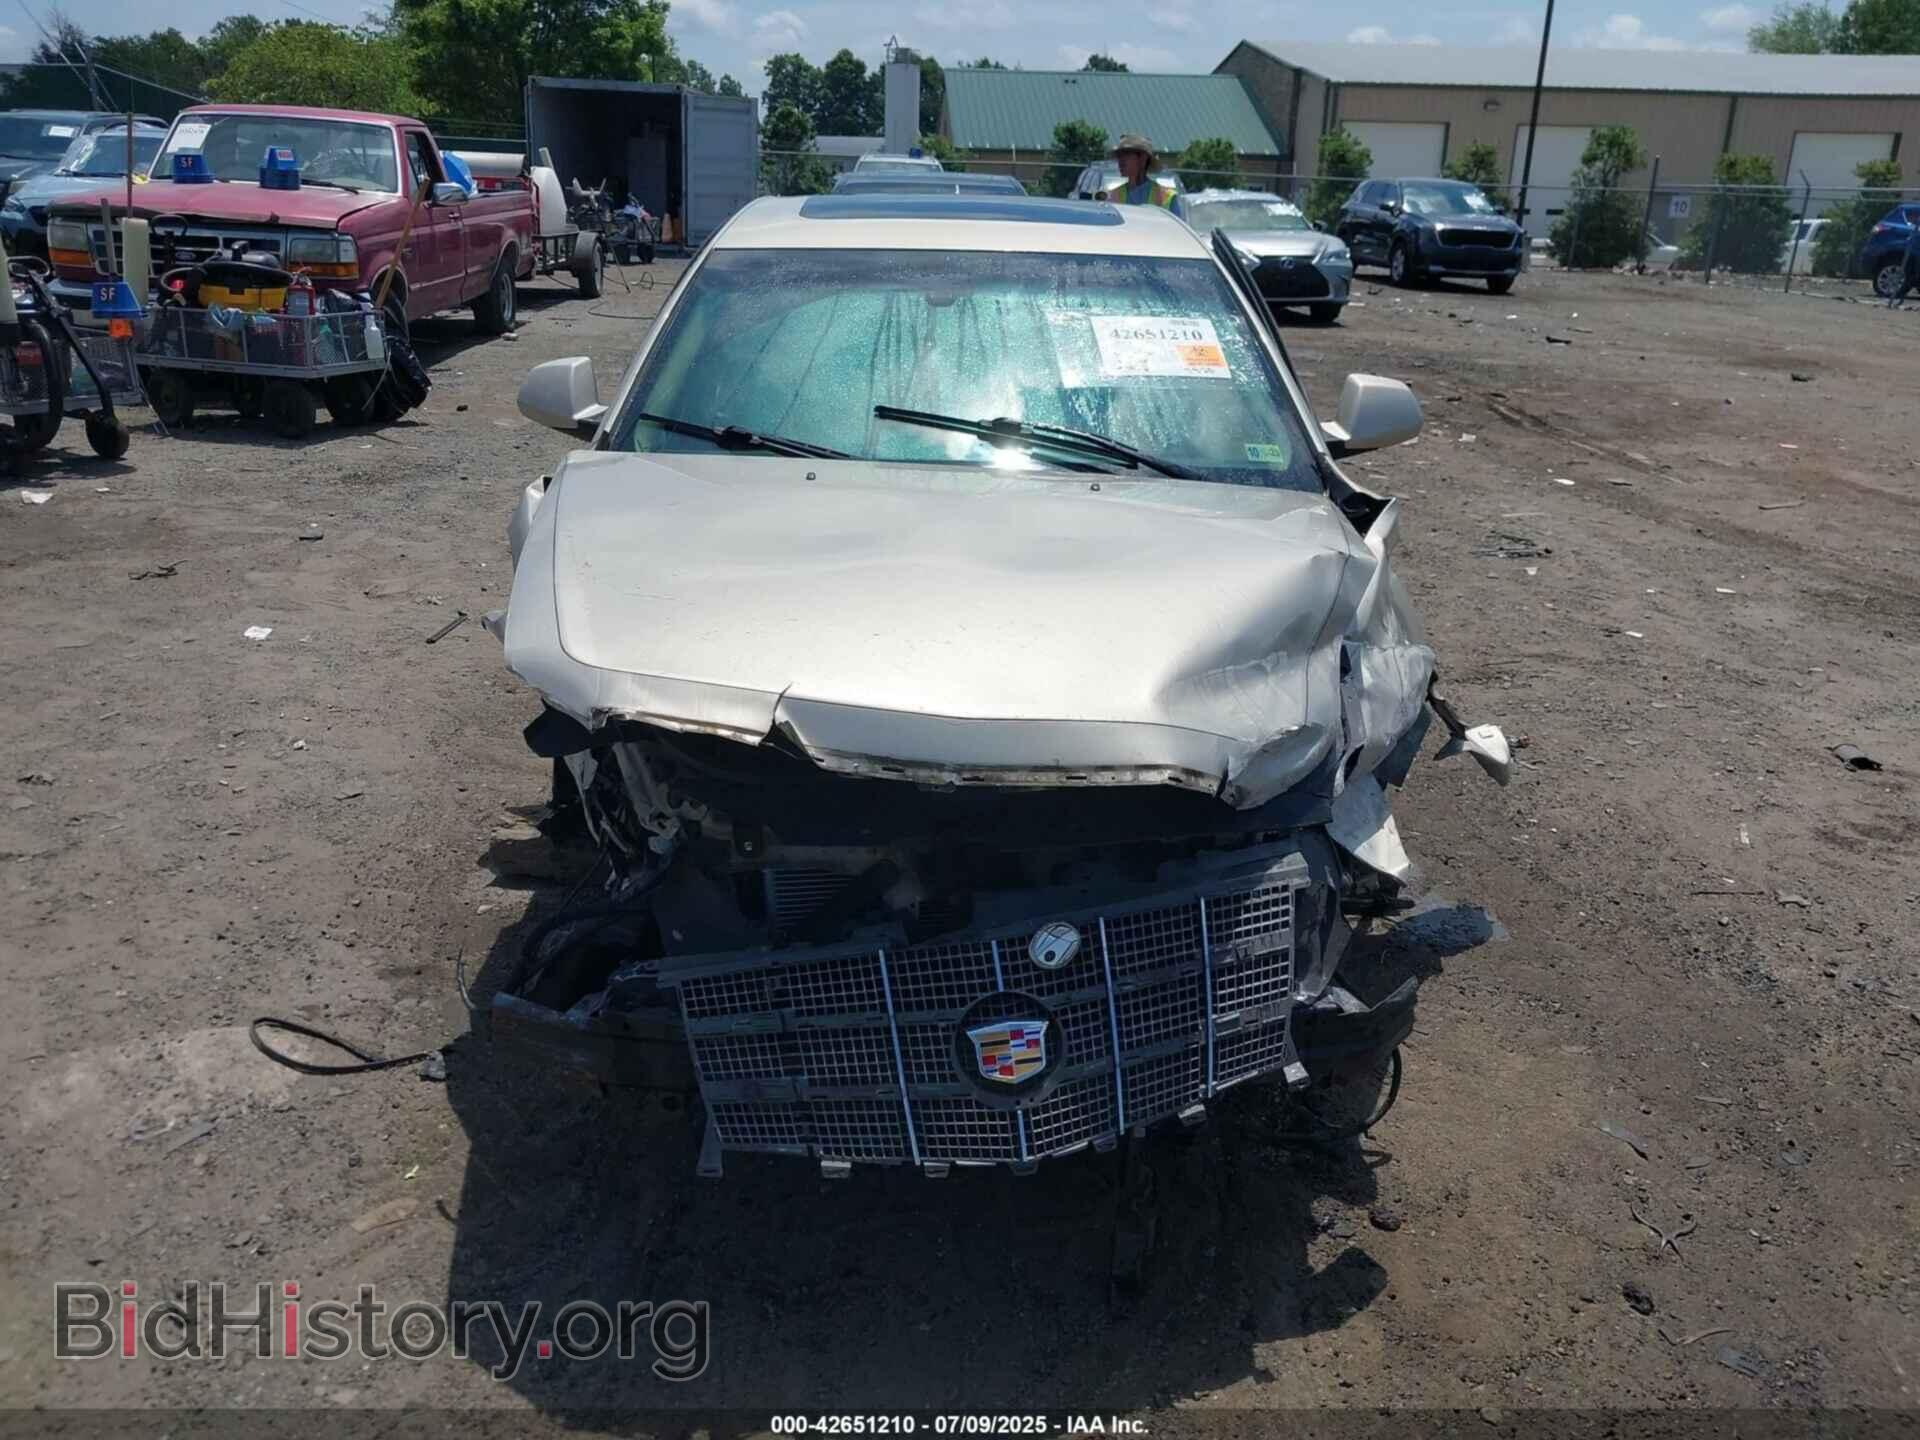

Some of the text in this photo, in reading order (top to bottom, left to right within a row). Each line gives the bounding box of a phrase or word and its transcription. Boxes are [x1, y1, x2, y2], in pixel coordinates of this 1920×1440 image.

[1674, 200, 1688, 214] 10
[100, 287, 116, 301] SF
[1110, 328, 1203, 341] 42651210
